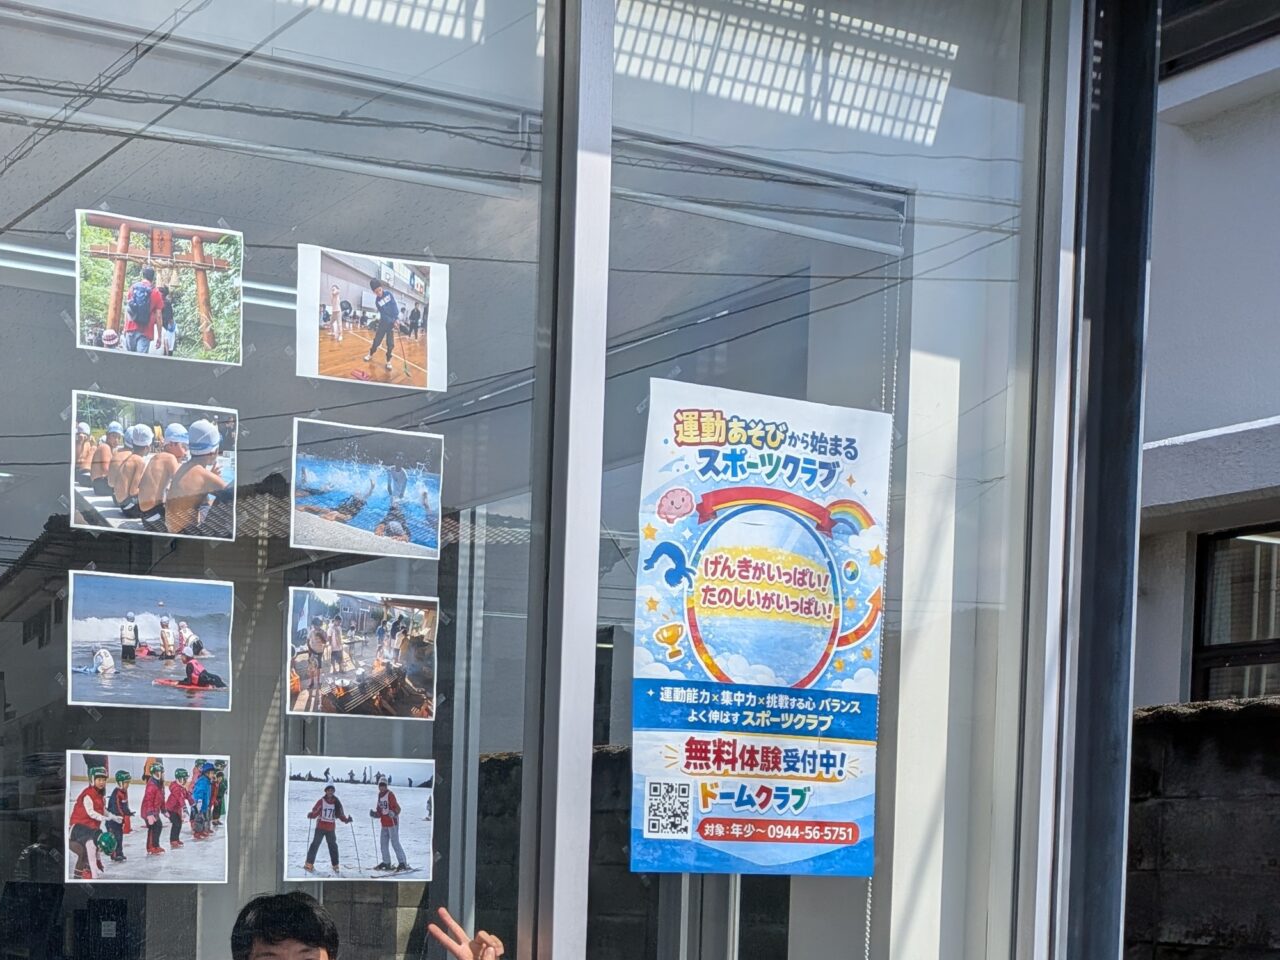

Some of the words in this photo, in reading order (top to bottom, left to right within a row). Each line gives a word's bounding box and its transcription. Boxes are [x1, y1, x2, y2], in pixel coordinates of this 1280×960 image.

[674, 409, 859, 461] 運動あそびから始まる
[698, 448, 841, 489] スポーツクラブ
[704, 555, 830, 593] げんきがいっぱい!
[701, 585, 833, 619] たのしいがいっぱい!
[684, 736, 847, 777] 無料体験受付中!
[701, 782, 811, 811] ドームクラブ
